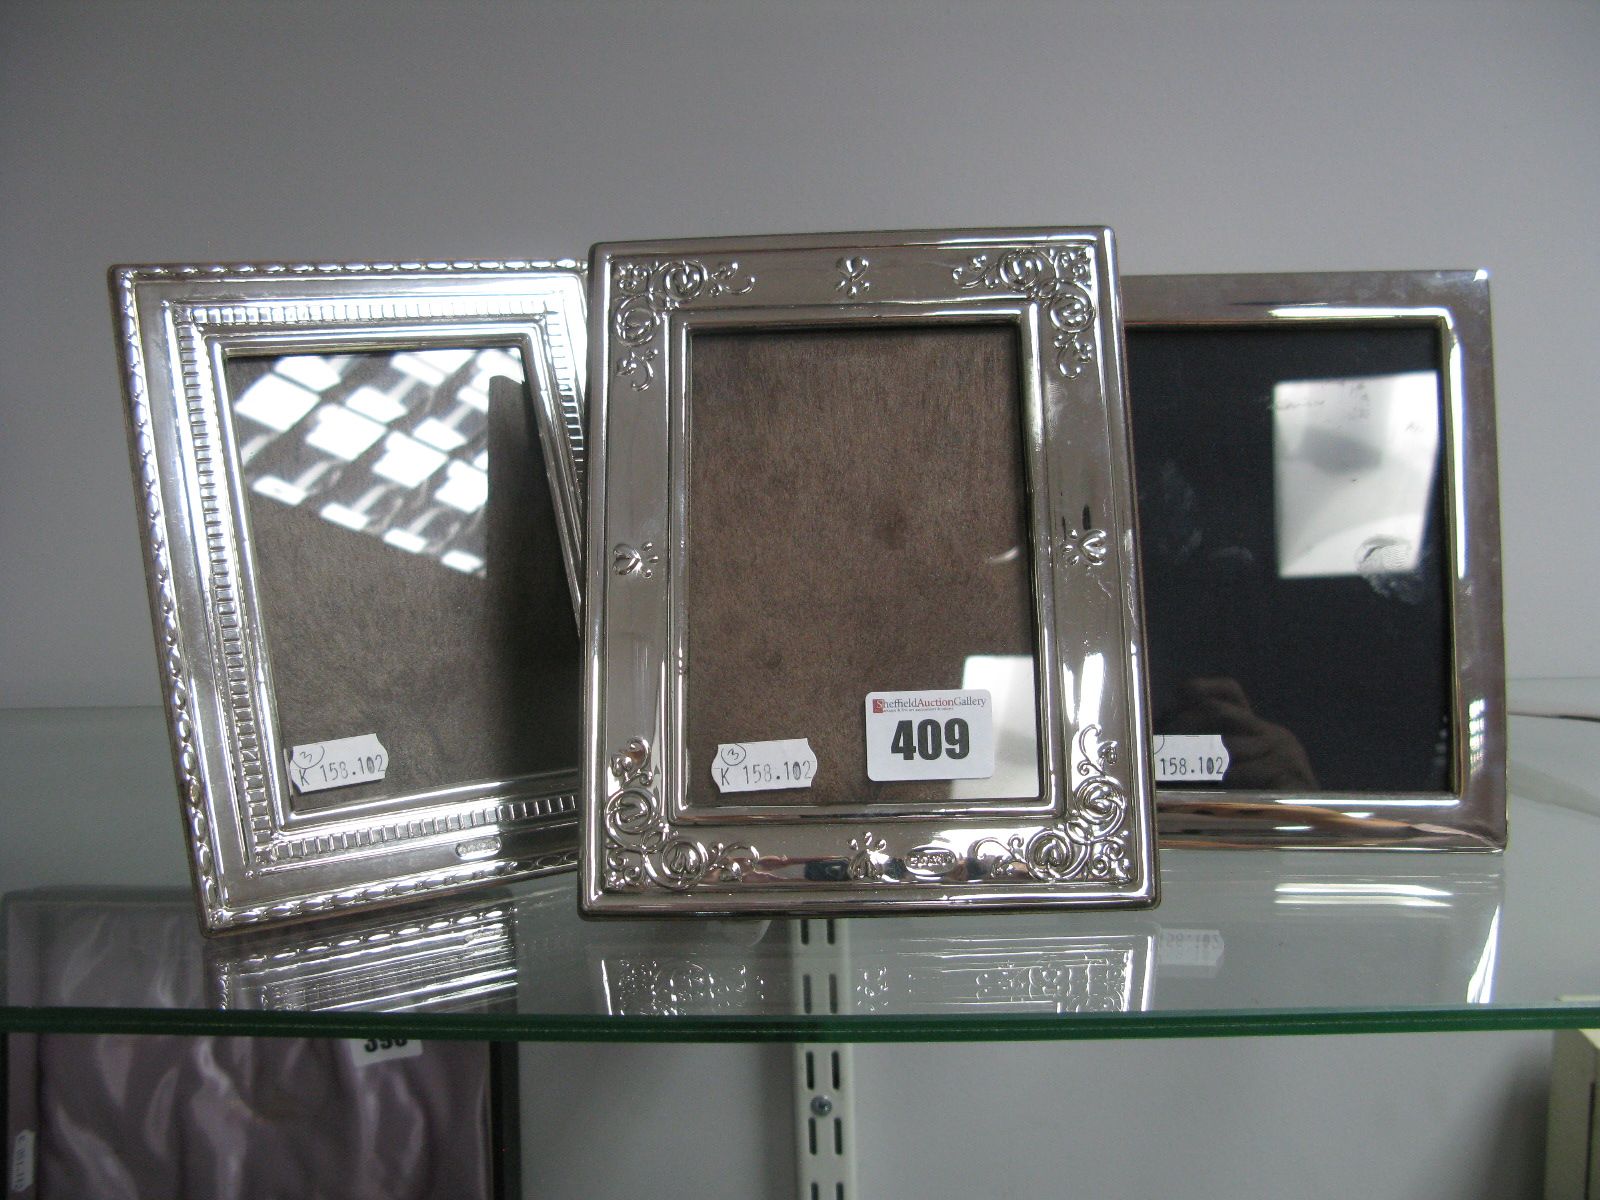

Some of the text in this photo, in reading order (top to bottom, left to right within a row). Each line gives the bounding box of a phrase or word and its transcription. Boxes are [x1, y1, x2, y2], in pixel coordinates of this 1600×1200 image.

[890, 717, 970, 761] 409
[299, 751, 313, 763] 3
[727, 748, 740, 761] 3
[1160, 756, 1224, 776] 158.102
[299, 754, 386, 787] K 158.102
[720, 760, 812, 786] K 158.102
